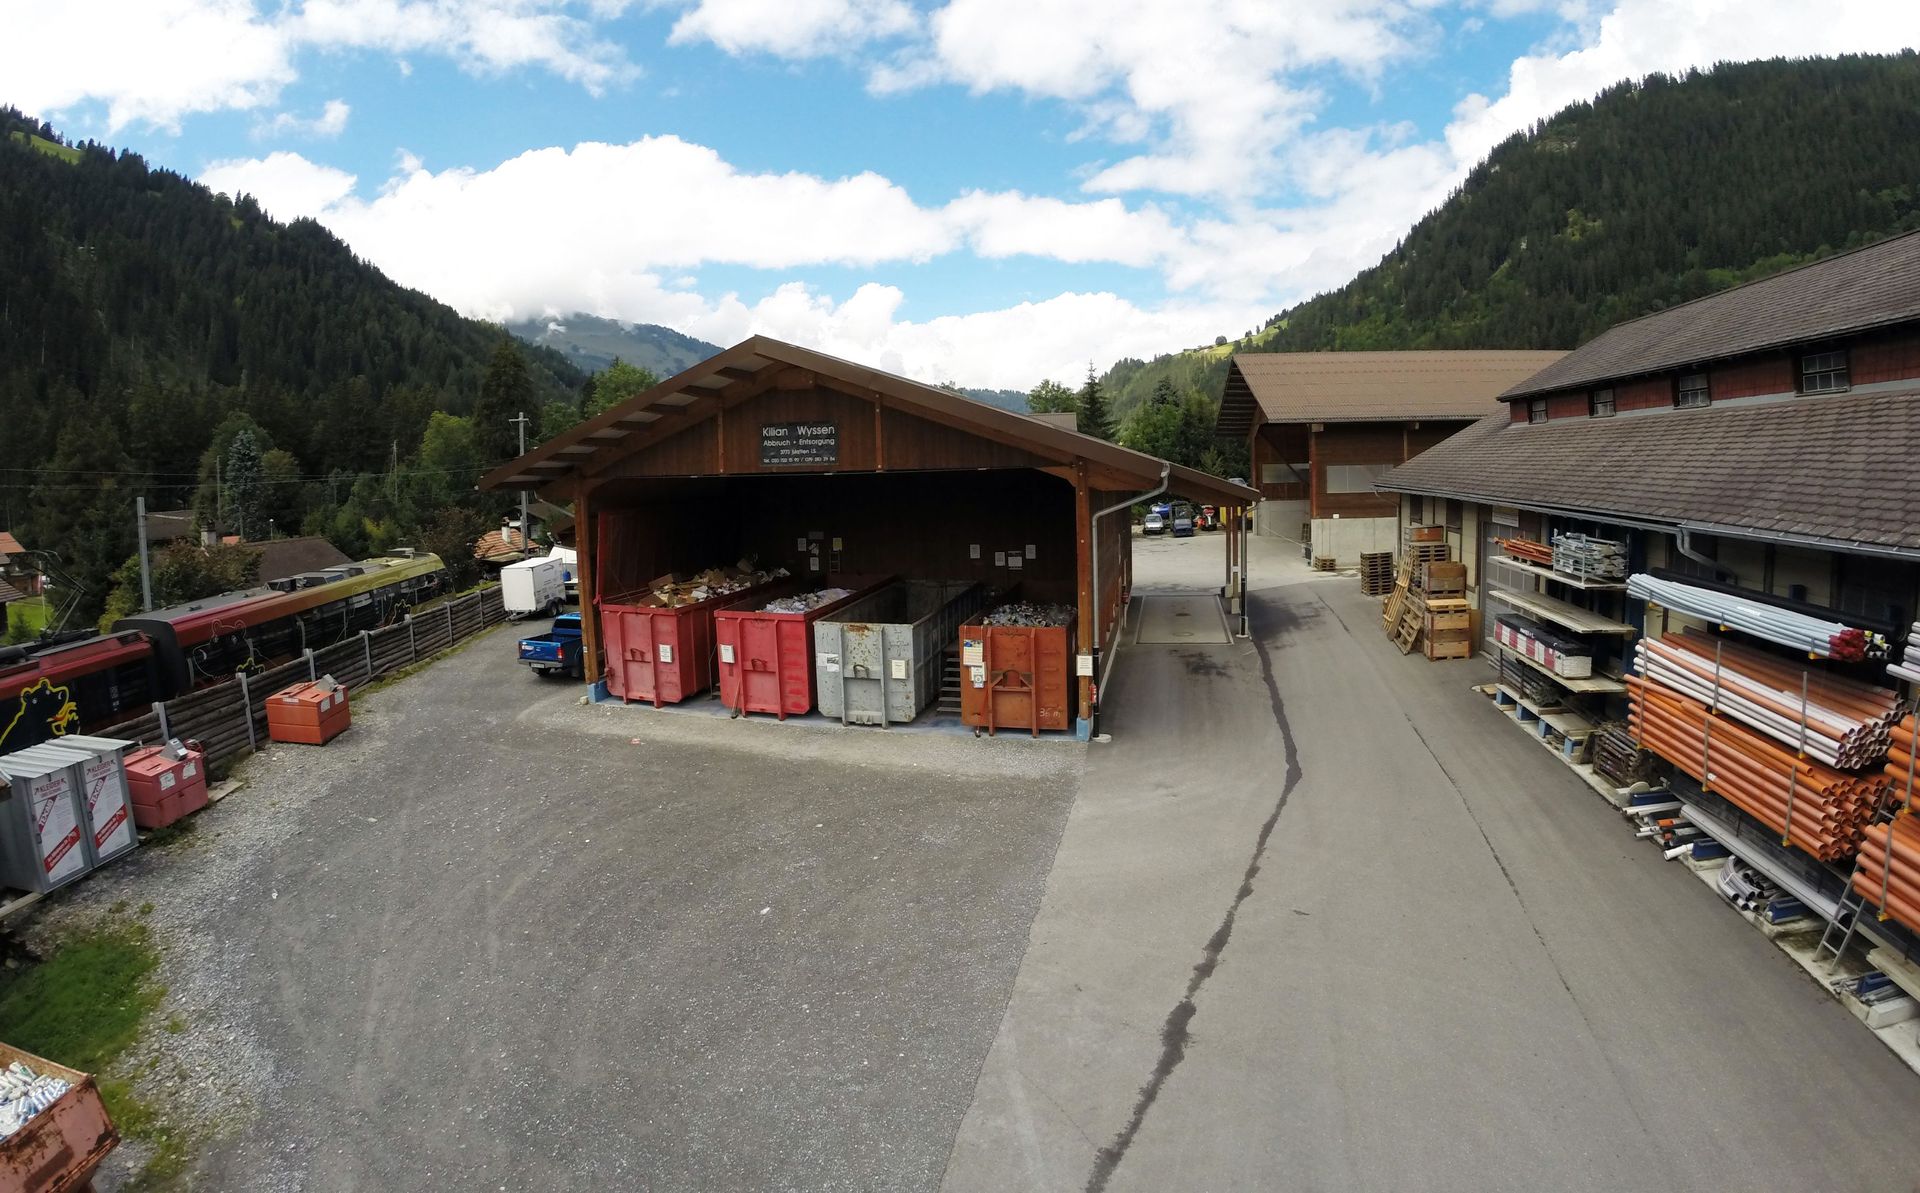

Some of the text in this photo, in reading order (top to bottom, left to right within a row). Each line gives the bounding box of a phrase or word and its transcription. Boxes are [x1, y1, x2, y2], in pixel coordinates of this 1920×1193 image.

[762, 426, 834, 436] Kilian Wyssen
[90, 779, 104, 805] TEXAID
[39, 800, 54, 827] TEXAID
